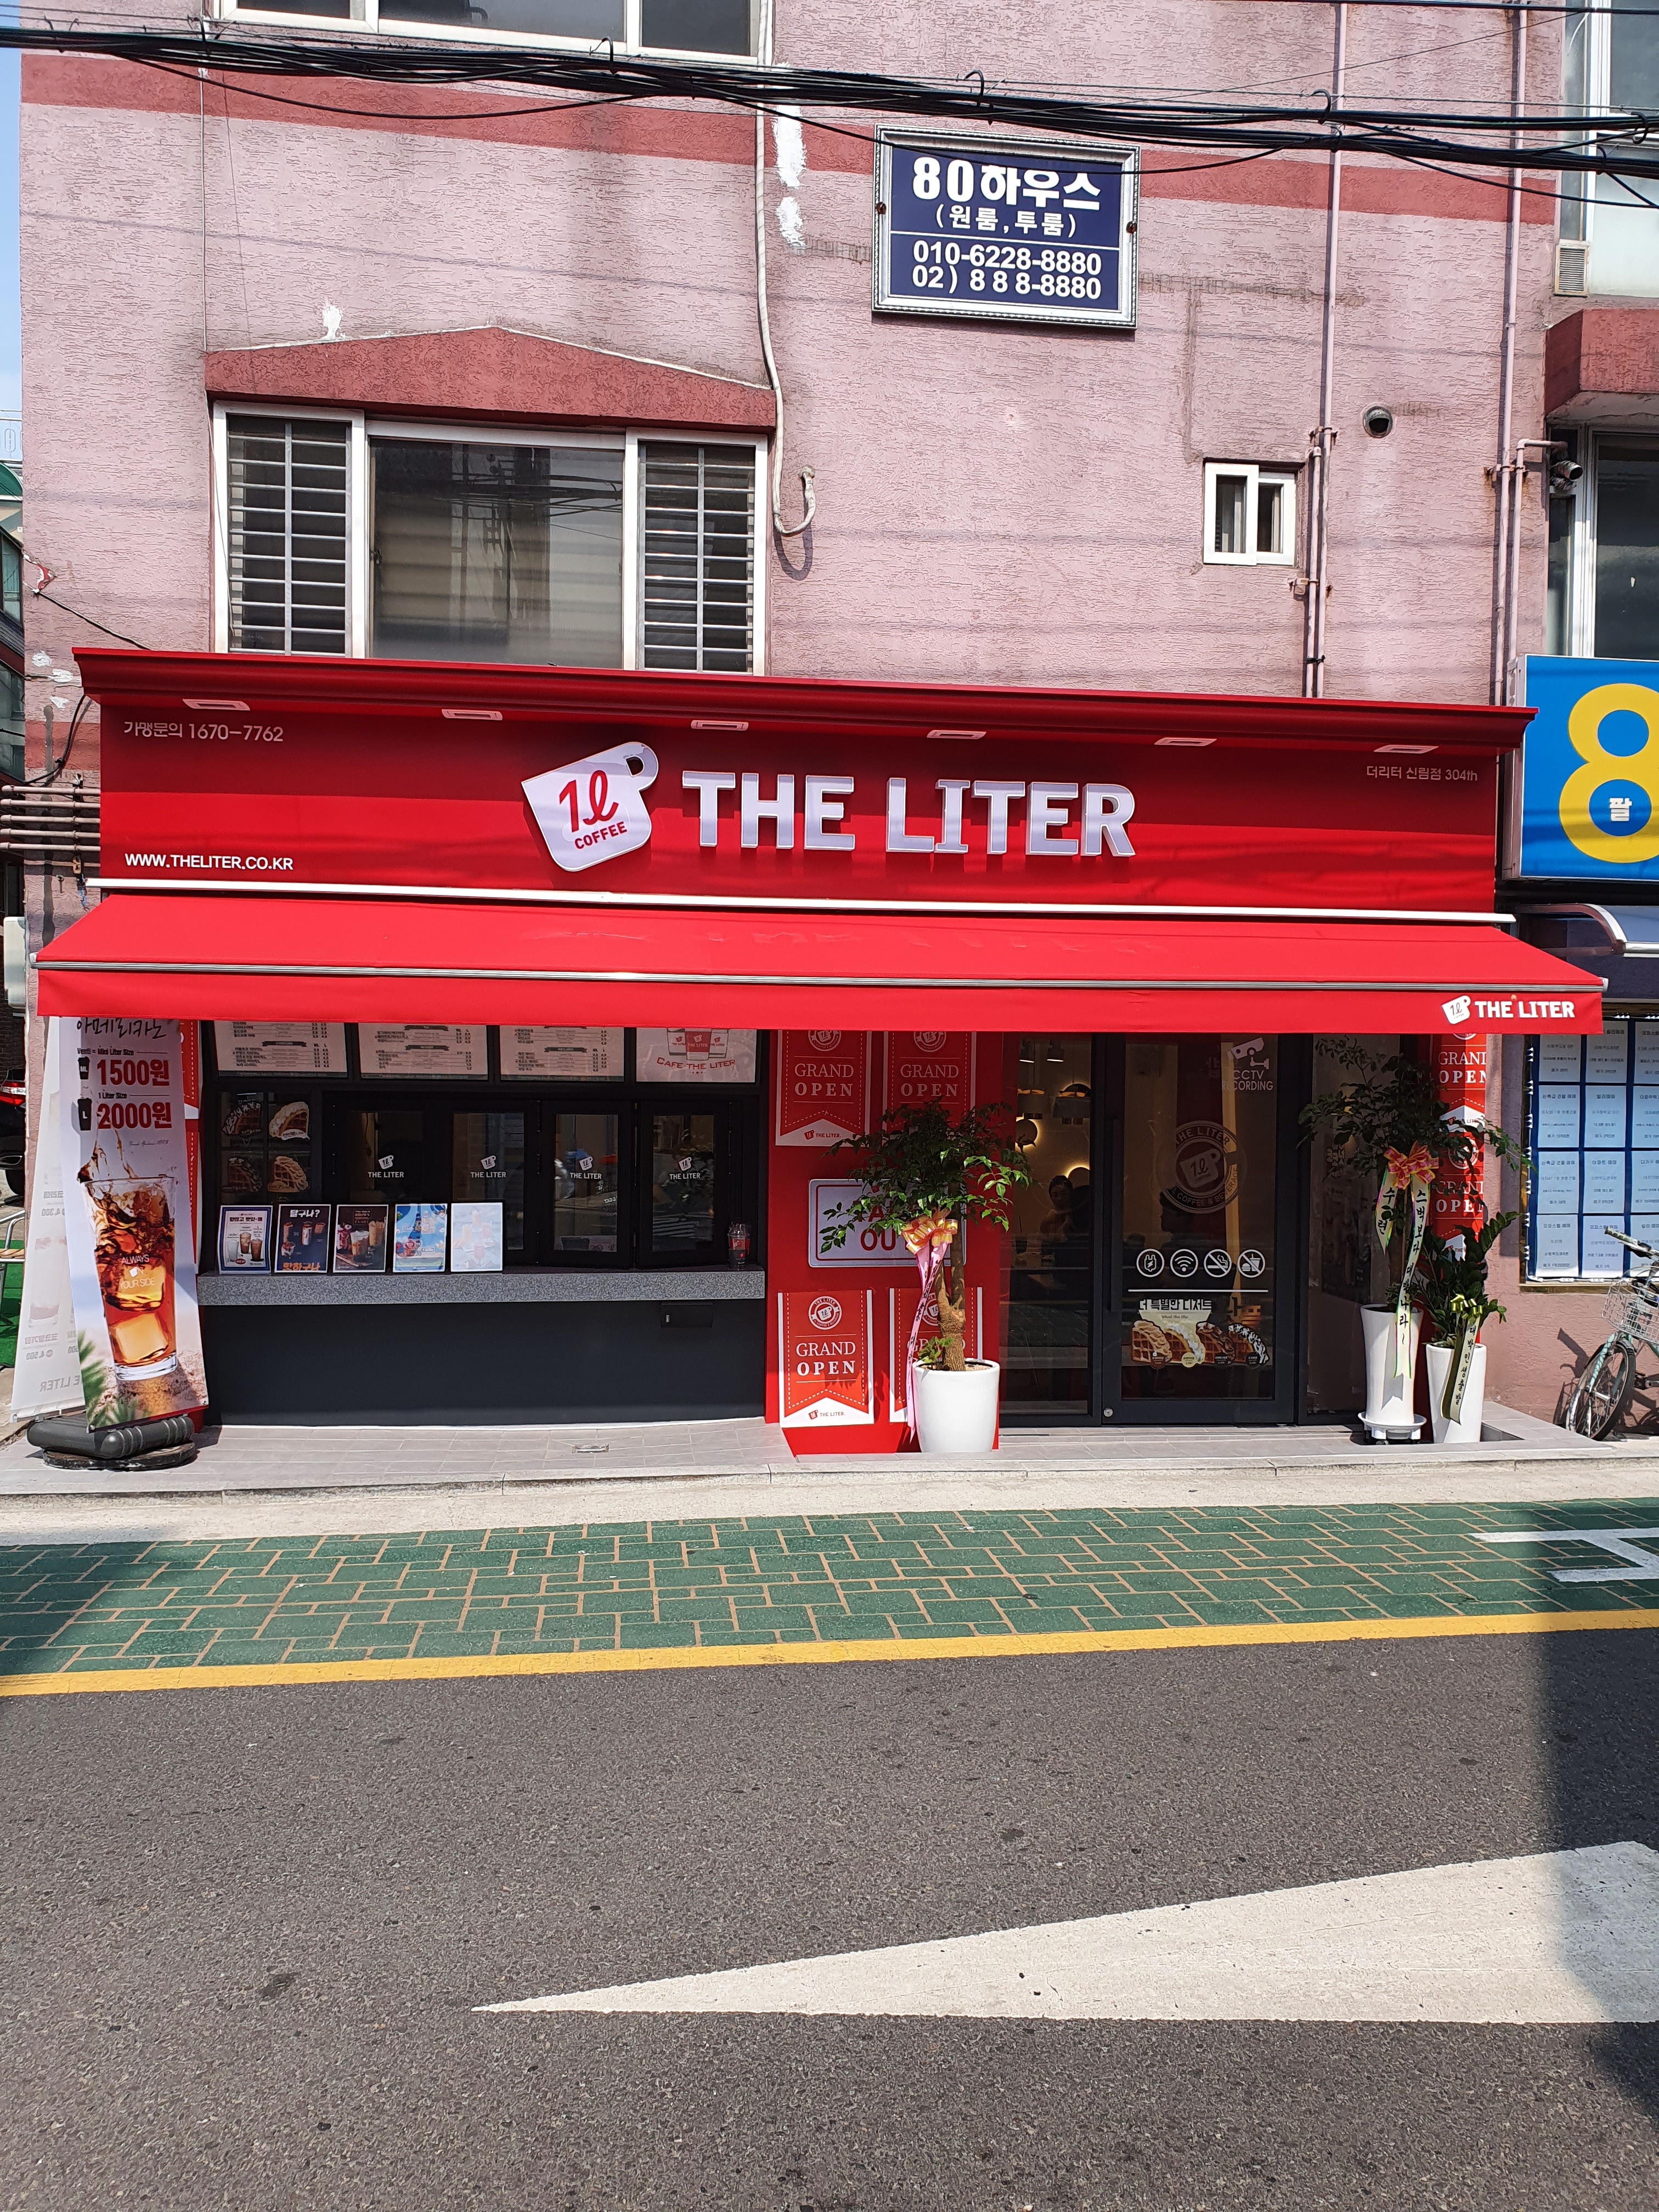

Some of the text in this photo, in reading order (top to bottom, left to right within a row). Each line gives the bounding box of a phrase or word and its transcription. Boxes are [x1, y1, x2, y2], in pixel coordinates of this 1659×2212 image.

[913, 240, 1102, 275] 010-6228-8880
[124, 721, 284, 742] 가맹문의 1670-7762
[1367, 765, 1478, 782] 더리터 신림점 304th
[1559, 683, 1659, 864] 8
[682, 770, 1136, 858] THE LITER
[1609, 797, 1632, 822] 팔
[574, 821, 628, 849] COFFEE
[125, 853, 294, 871] WWW.THELITER.CO.KR
[1475, 1001, 1575, 1018] THE LITER
[77, 1018, 166, 1039] 아메리카노
[110, 1047, 122, 1056] Liter
[657, 1057, 684, 1069] CAFE
[710, 1059, 736, 1069] LITER
[794, 1063, 854, 1078] GRAND
[97, 1059, 170, 1086] 1500원
[900, 1064, 959, 1079] GRAND
[1234, 1070, 1264, 1080] CCTV
[795, 1082, 853, 1097] OPEN
[901, 1083, 958, 1097] OPEN
[1222, 1081, 1273, 1091] RECORDING
[97, 1102, 172, 1129] 2000원
[121, 1254, 149, 1264] ALWAYS
[120, 1277, 155, 1290] YOUR SIDE
[1139, 1299, 1212, 1311] 더 특별한 디저트
[796, 1341, 856, 1357] GRAND
[797, 1361, 856, 1376] OPEN
